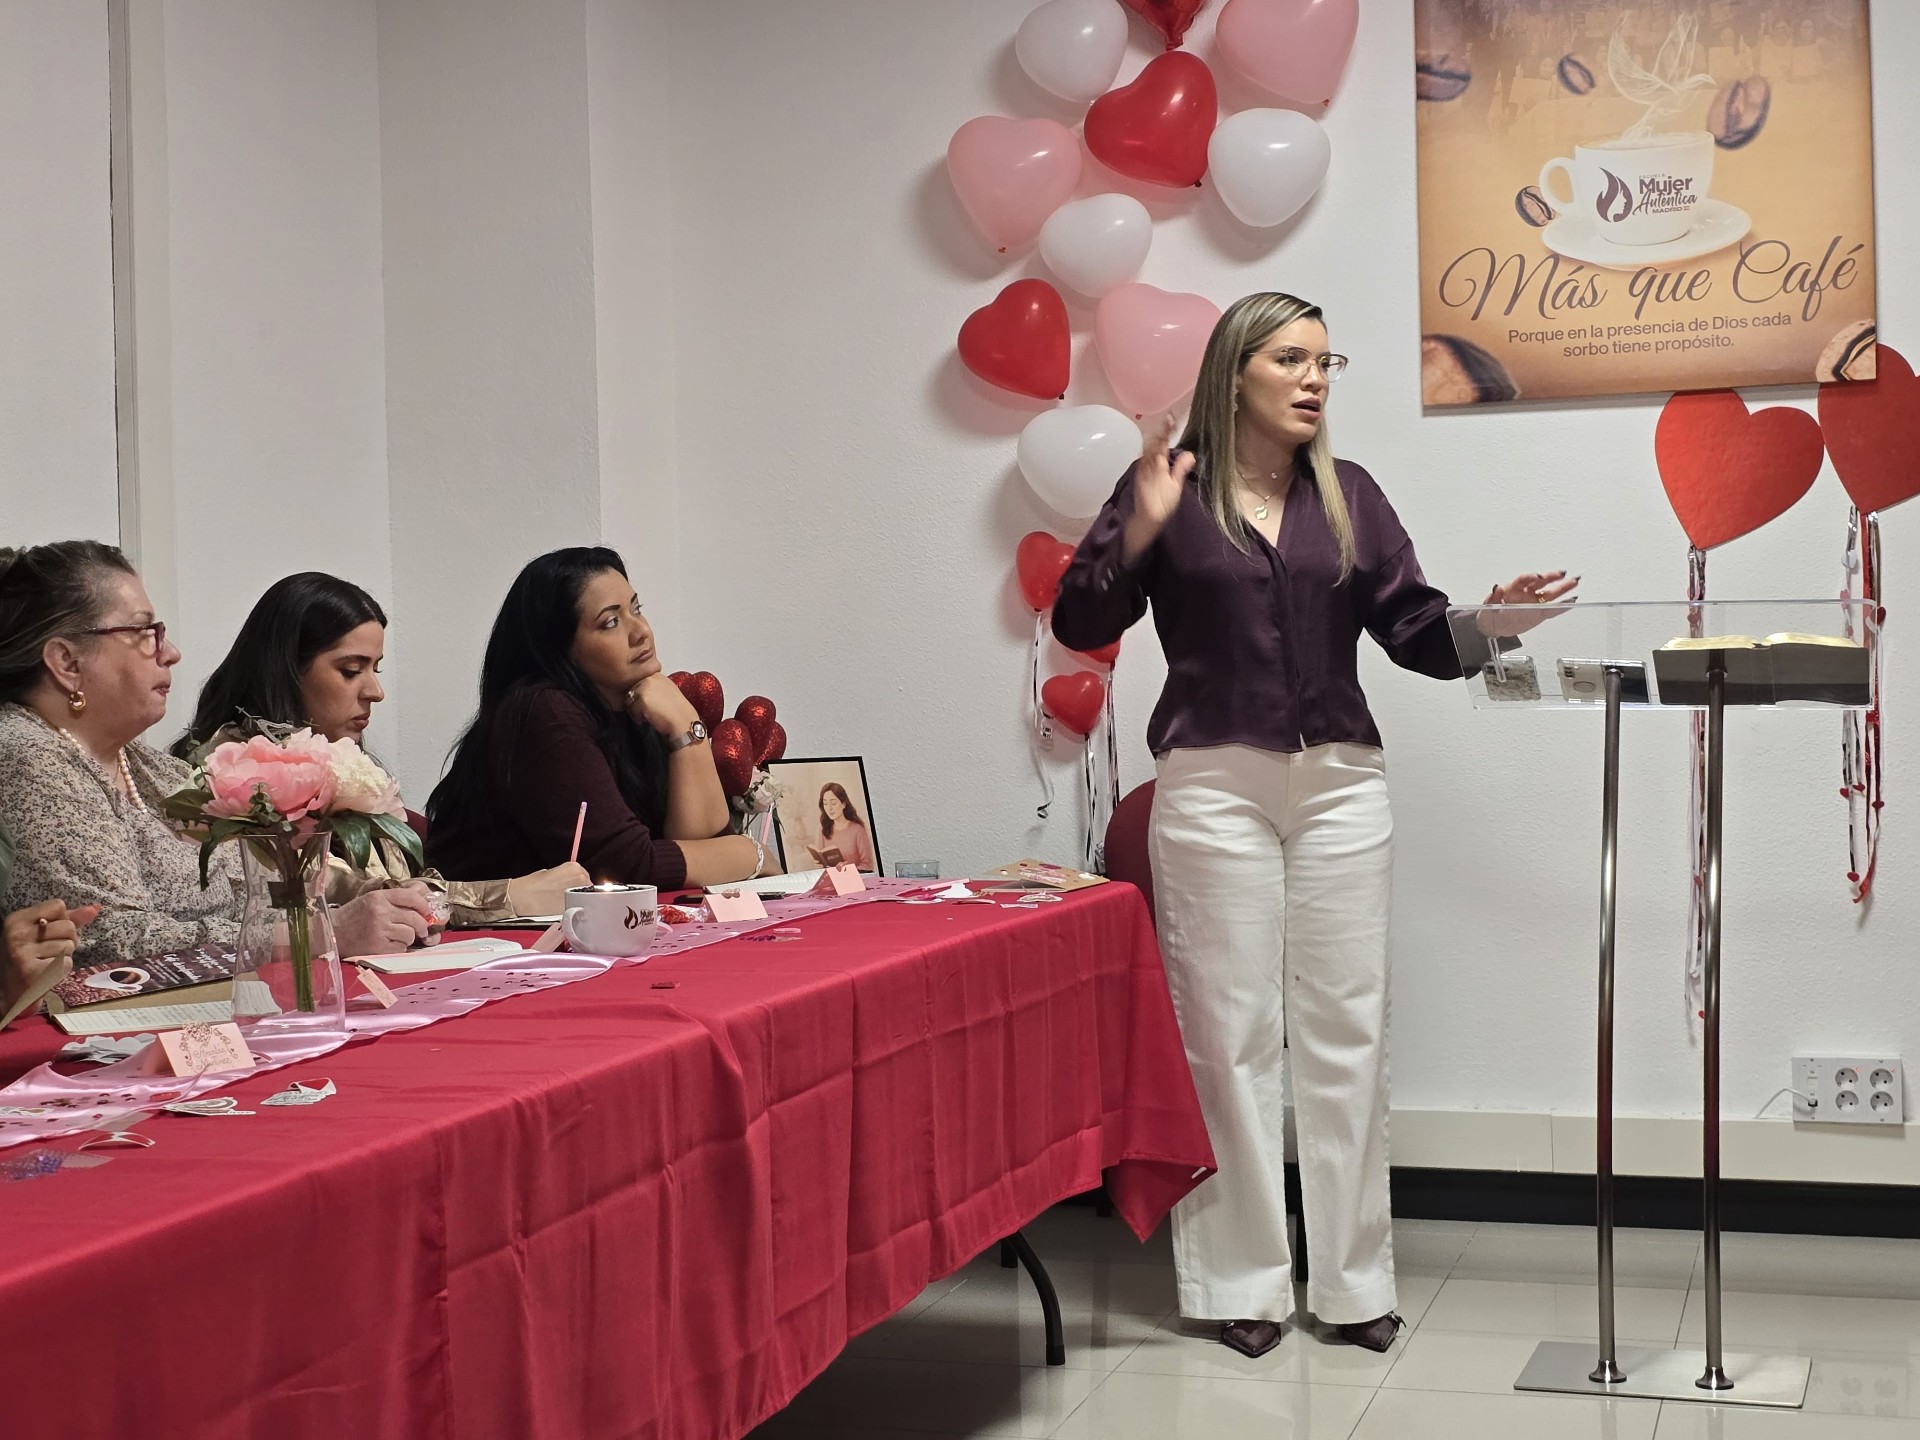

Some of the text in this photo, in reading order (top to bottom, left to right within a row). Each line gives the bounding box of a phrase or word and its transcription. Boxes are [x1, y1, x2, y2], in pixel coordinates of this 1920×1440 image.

[1639, 176, 1693, 195] Mujer
[1652, 206, 1683, 214] MADRID
[1439, 235, 1865, 322] Más que Café
[1508, 311, 1792, 345] Porque en la presencia de Dios cada
[1563, 333, 1735, 358] sorbo tiene propósito.
